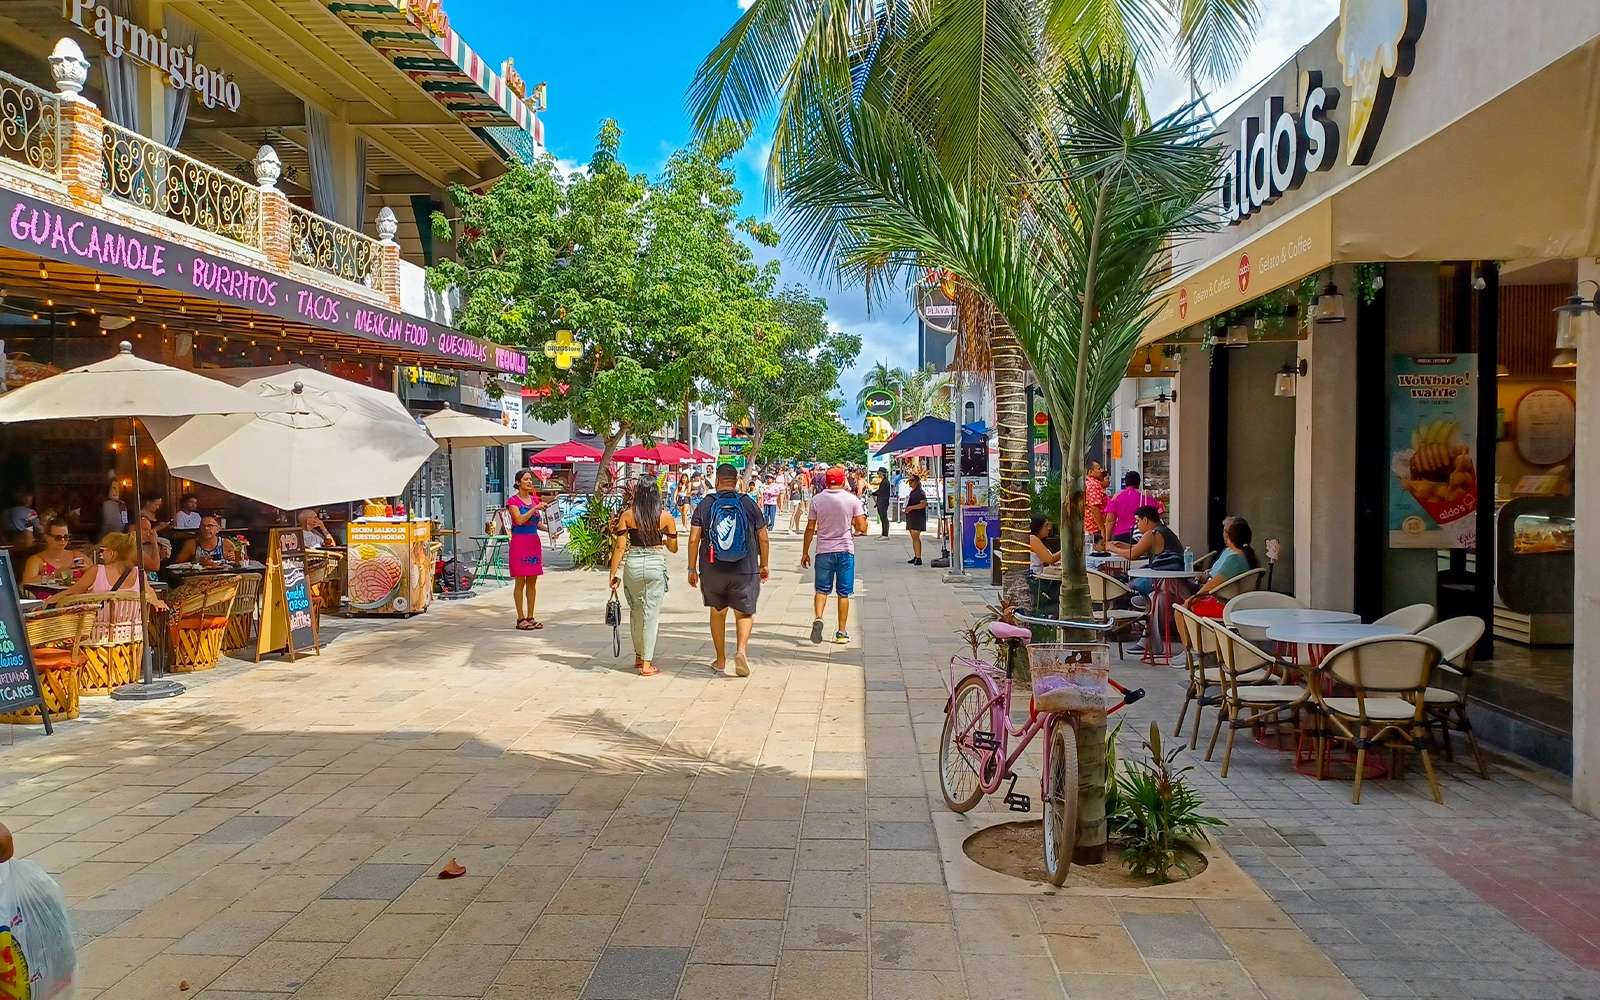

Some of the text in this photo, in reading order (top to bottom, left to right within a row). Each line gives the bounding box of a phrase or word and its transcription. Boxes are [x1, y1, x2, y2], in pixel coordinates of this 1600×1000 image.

[70, 0, 240, 112] Parmigiano
[1258, 255, 1280, 274] Gelato
[1287, 234, 1312, 261] Coffee
[10, 202, 528, 374] GUACAMOLE BURRITOS TACOS MEXICAN FOOD QUESADILLAS TEQUILA
[1411, 388, 1458, 399] waffle
[1439, 503, 1466, 520] aldo's
